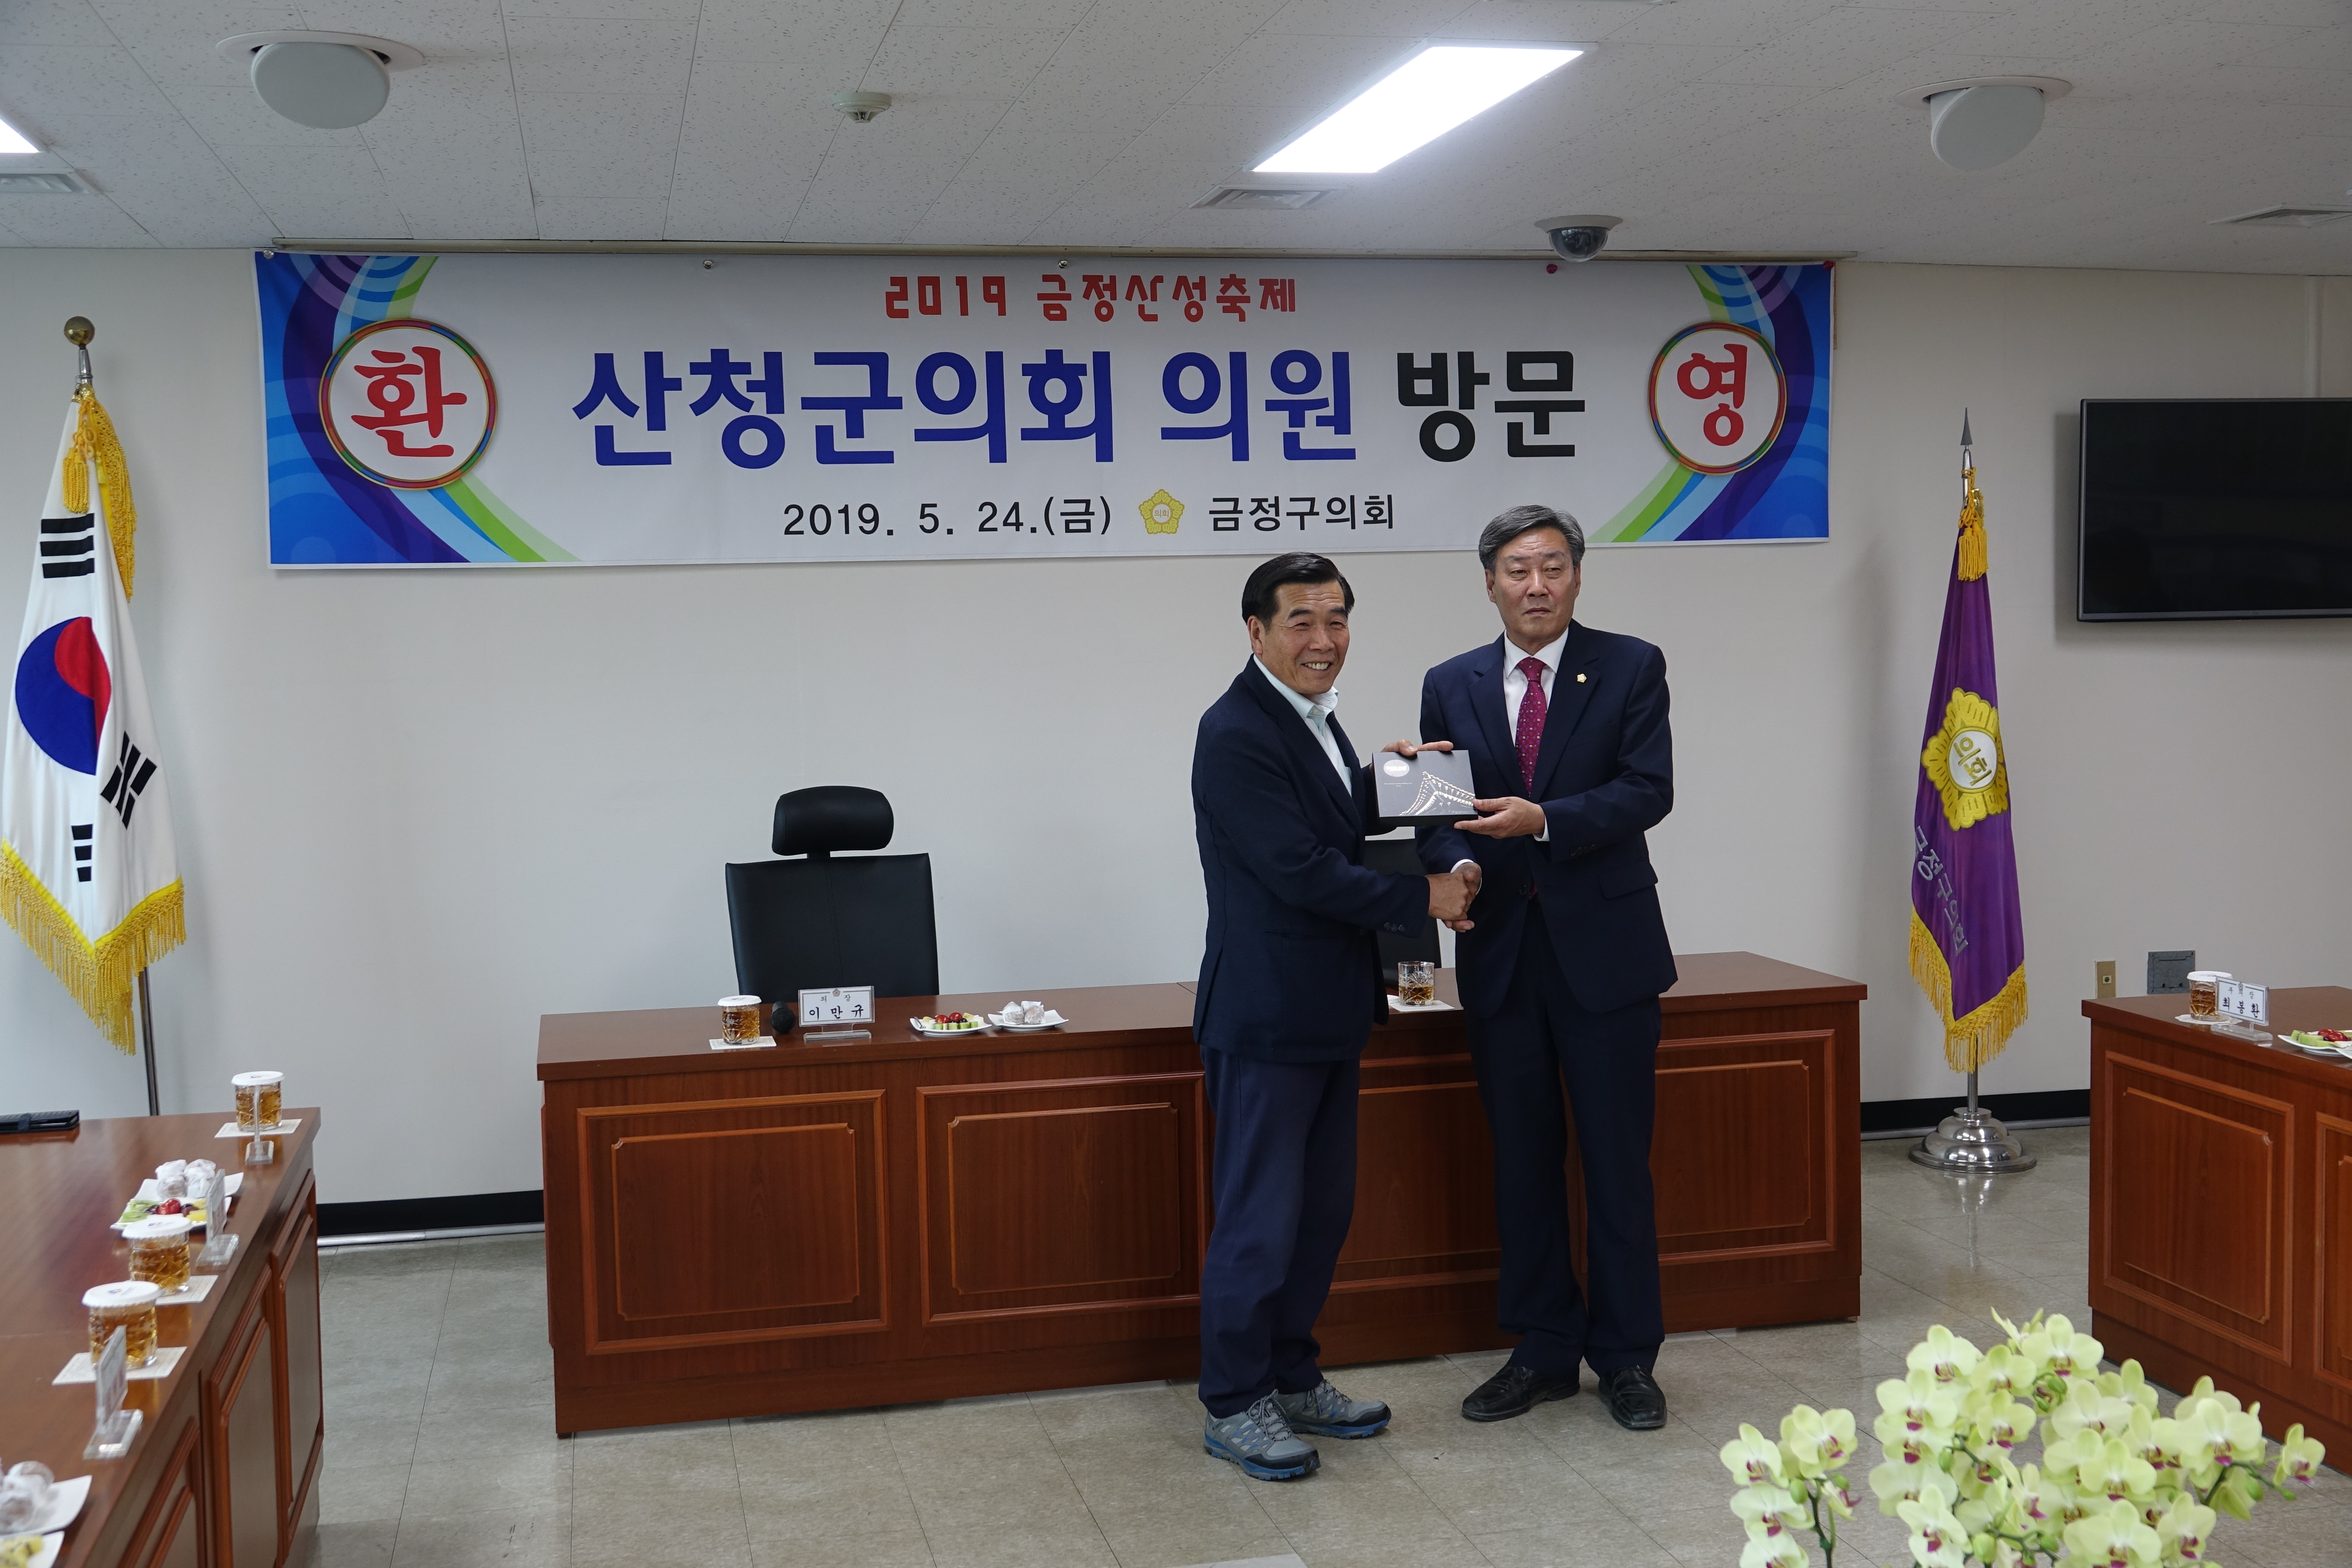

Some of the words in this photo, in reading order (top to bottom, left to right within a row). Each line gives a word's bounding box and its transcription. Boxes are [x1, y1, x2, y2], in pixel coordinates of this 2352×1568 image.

[885, 276, 1006, 318] 2019
[1037, 273, 1295, 322] 금정산성축제
[352, 346, 467, 457] 환
[573, 349, 1113, 469] 산청군의회
[1161, 350, 1356, 462] 의원
[1397, 351, 1585, 462] 방문
[1678, 344, 1747, 446] 영
[784, 504, 894, 535] 2019.
[919, 503, 953, 535] 5.
[978, 495, 1112, 536] 24.(금)
[1154, 509, 1169, 518] 의회
[1209, 494, 1394, 531] 금정구의회
[1954, 736, 1992, 786] 의회
